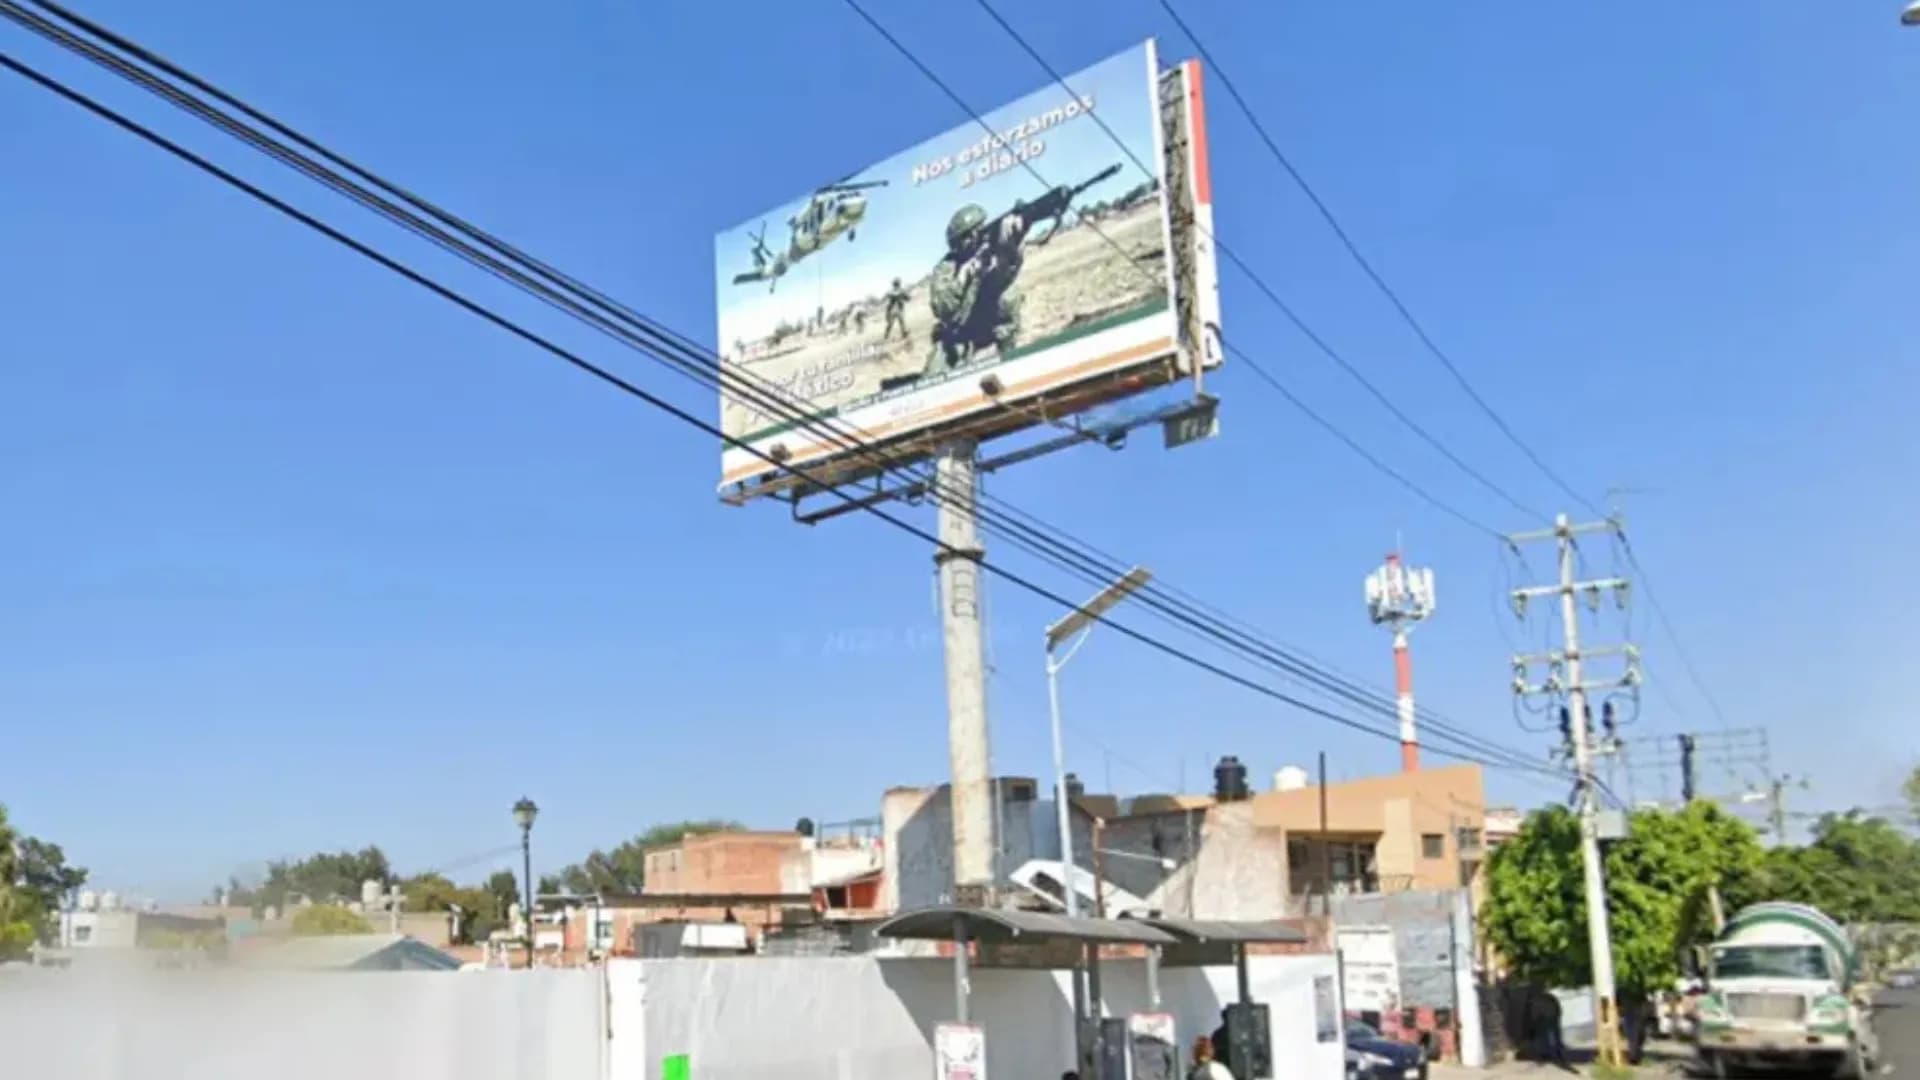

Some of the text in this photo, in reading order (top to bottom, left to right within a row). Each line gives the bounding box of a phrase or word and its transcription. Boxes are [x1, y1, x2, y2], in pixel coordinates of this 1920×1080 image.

[912, 95, 1095, 187] Nos esforzamos
[960, 139, 1045, 189] a diario
